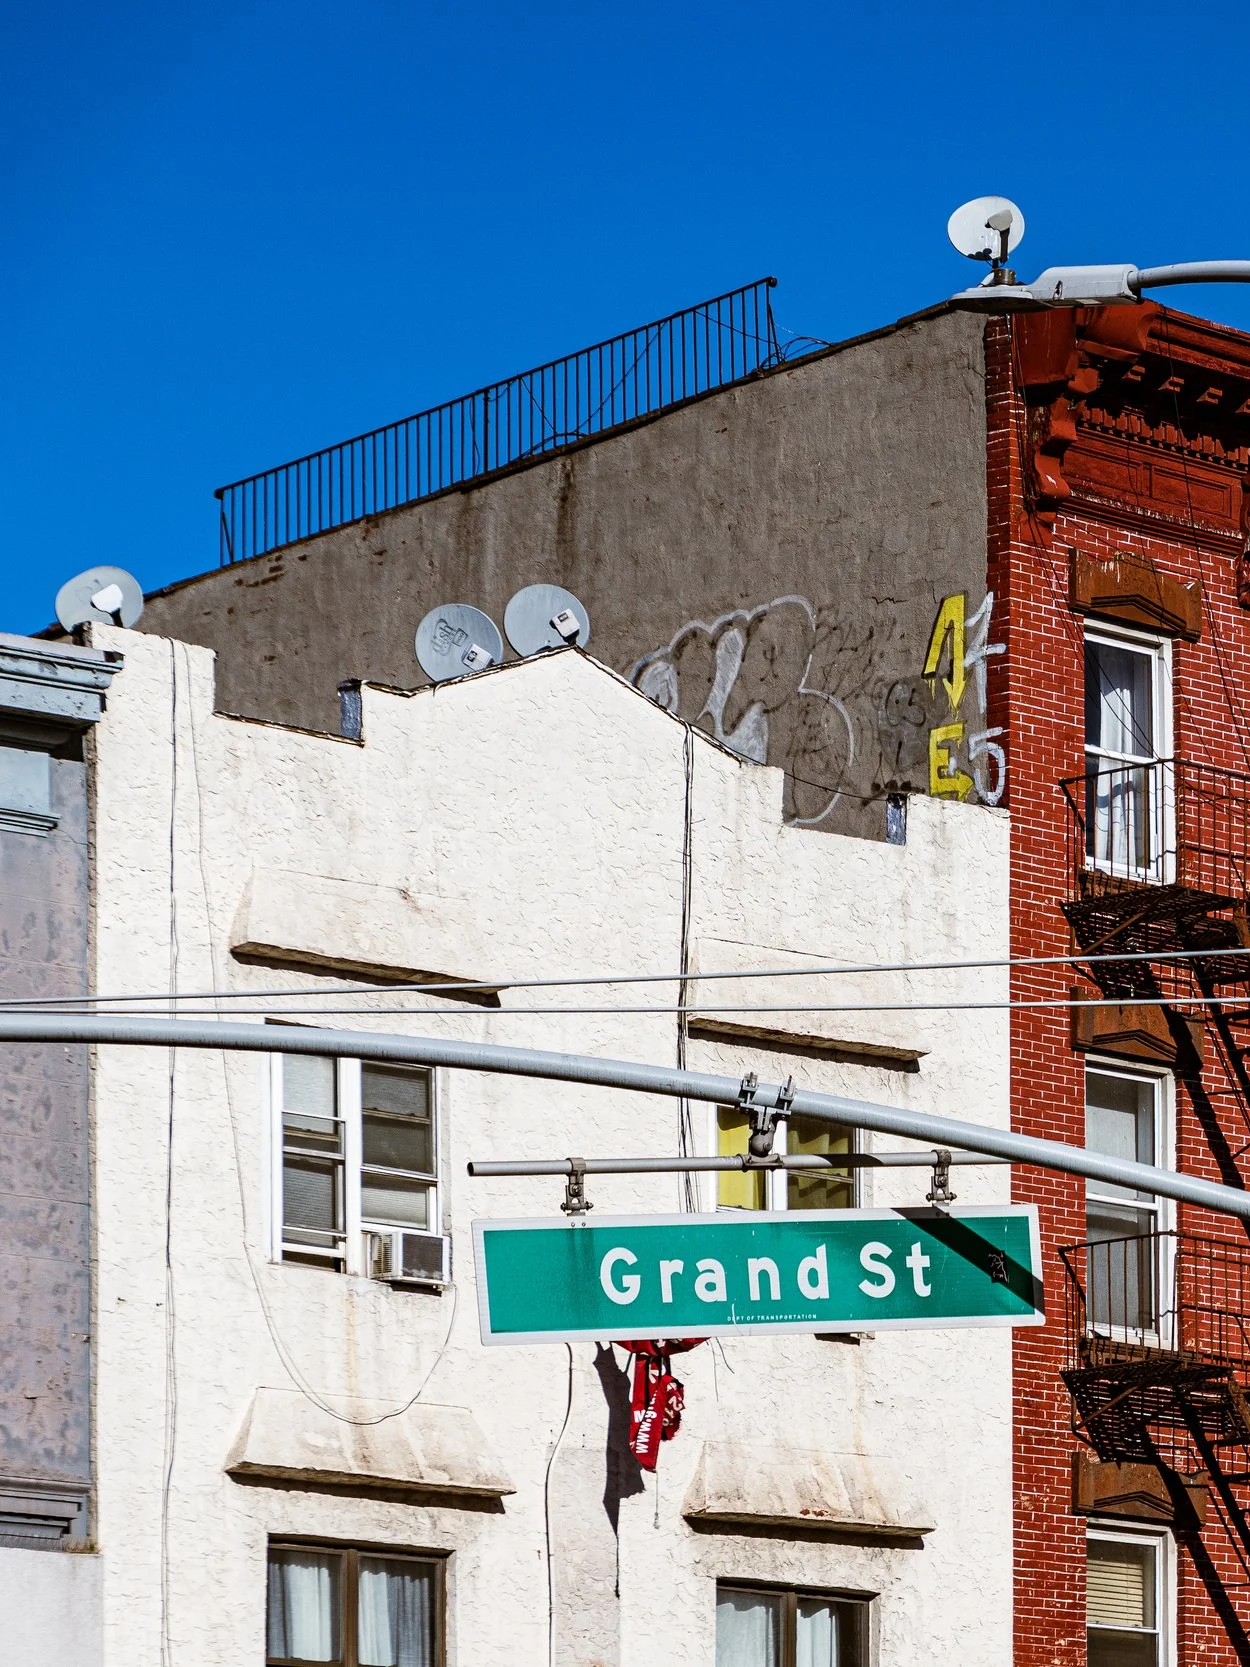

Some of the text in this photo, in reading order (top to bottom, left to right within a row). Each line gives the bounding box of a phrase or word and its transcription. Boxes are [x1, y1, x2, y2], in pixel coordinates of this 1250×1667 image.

[599, 1241, 830, 1305] Grand
[858, 1241, 932, 1299] St
[757, 1313, 817, 1321] TRANSPORTATION
